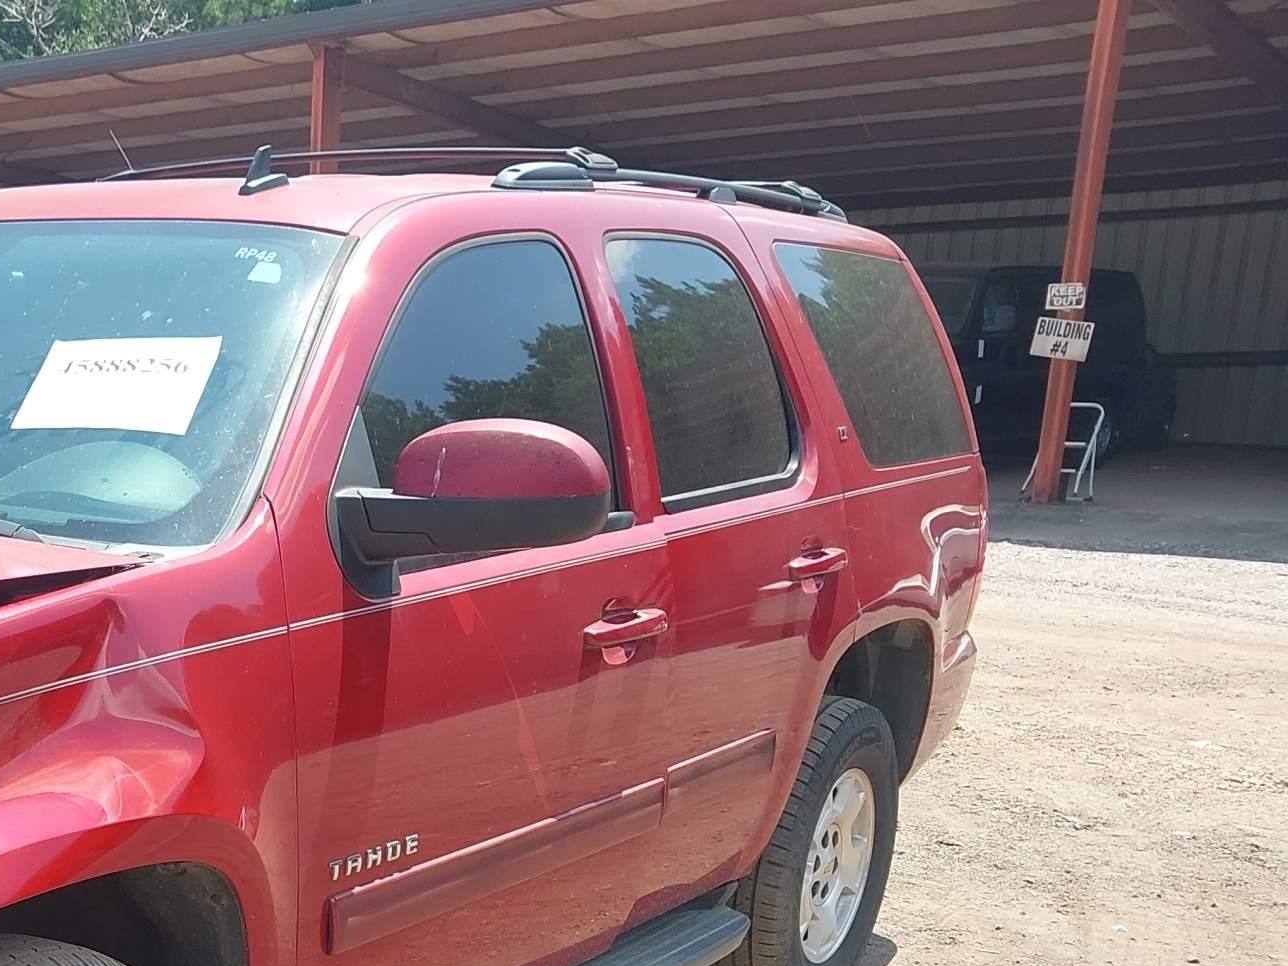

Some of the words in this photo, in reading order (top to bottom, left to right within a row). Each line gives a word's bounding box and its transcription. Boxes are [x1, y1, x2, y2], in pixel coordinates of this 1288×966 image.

[234, 247, 277, 262] RP48
[1051, 286, 1083, 296] KEEP
[1053, 296, 1079, 306] OUT
[1037, 319, 1091, 341] BUILDING
[1049, 340, 1069, 357] #4
[57, 358, 189, 375] 45888256
[329, 833, 419, 881] TAHOE
